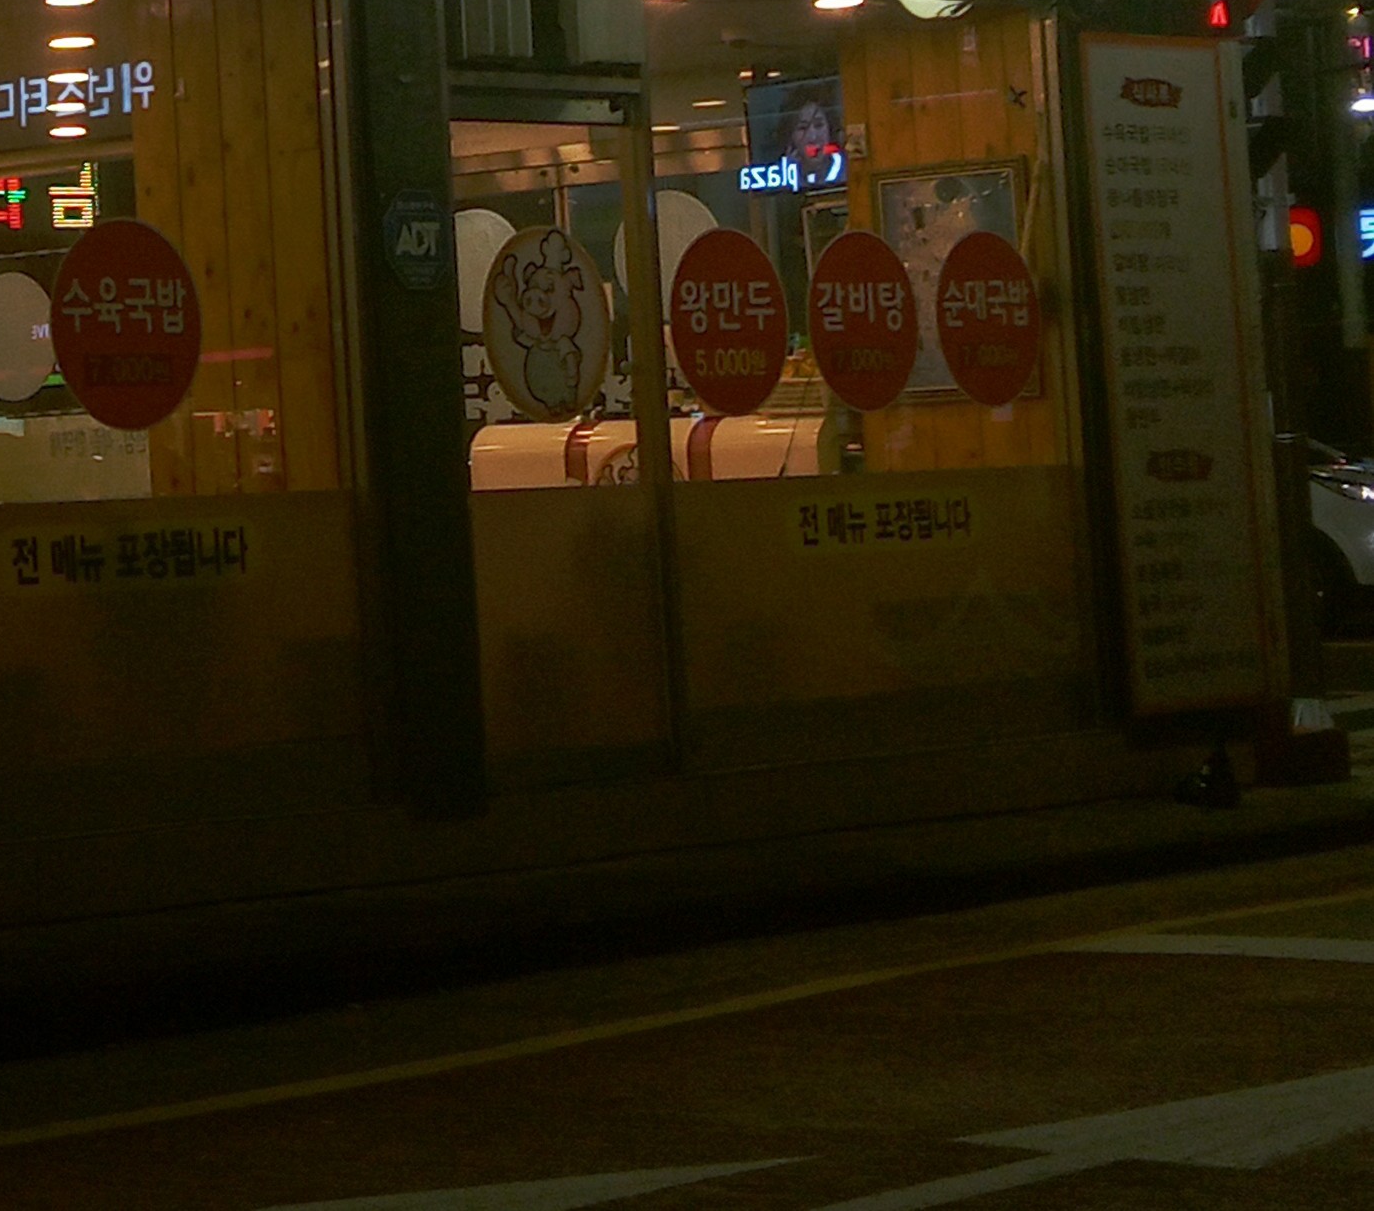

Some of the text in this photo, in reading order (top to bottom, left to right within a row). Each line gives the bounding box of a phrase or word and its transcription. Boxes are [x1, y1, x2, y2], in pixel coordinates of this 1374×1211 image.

[396, 221, 440, 256] ADT
[61, 275, 187, 334] 수육국밥
[678, 279, 776, 334] 왕만두
[816, 281, 905, 332] 갈비탕
[942, 279, 1030, 328] 순대국밥
[799, 496, 971, 548] 전 메뉴 포장됩니다
[11, 526, 249, 585] 전 메뉴 포장됩니다
